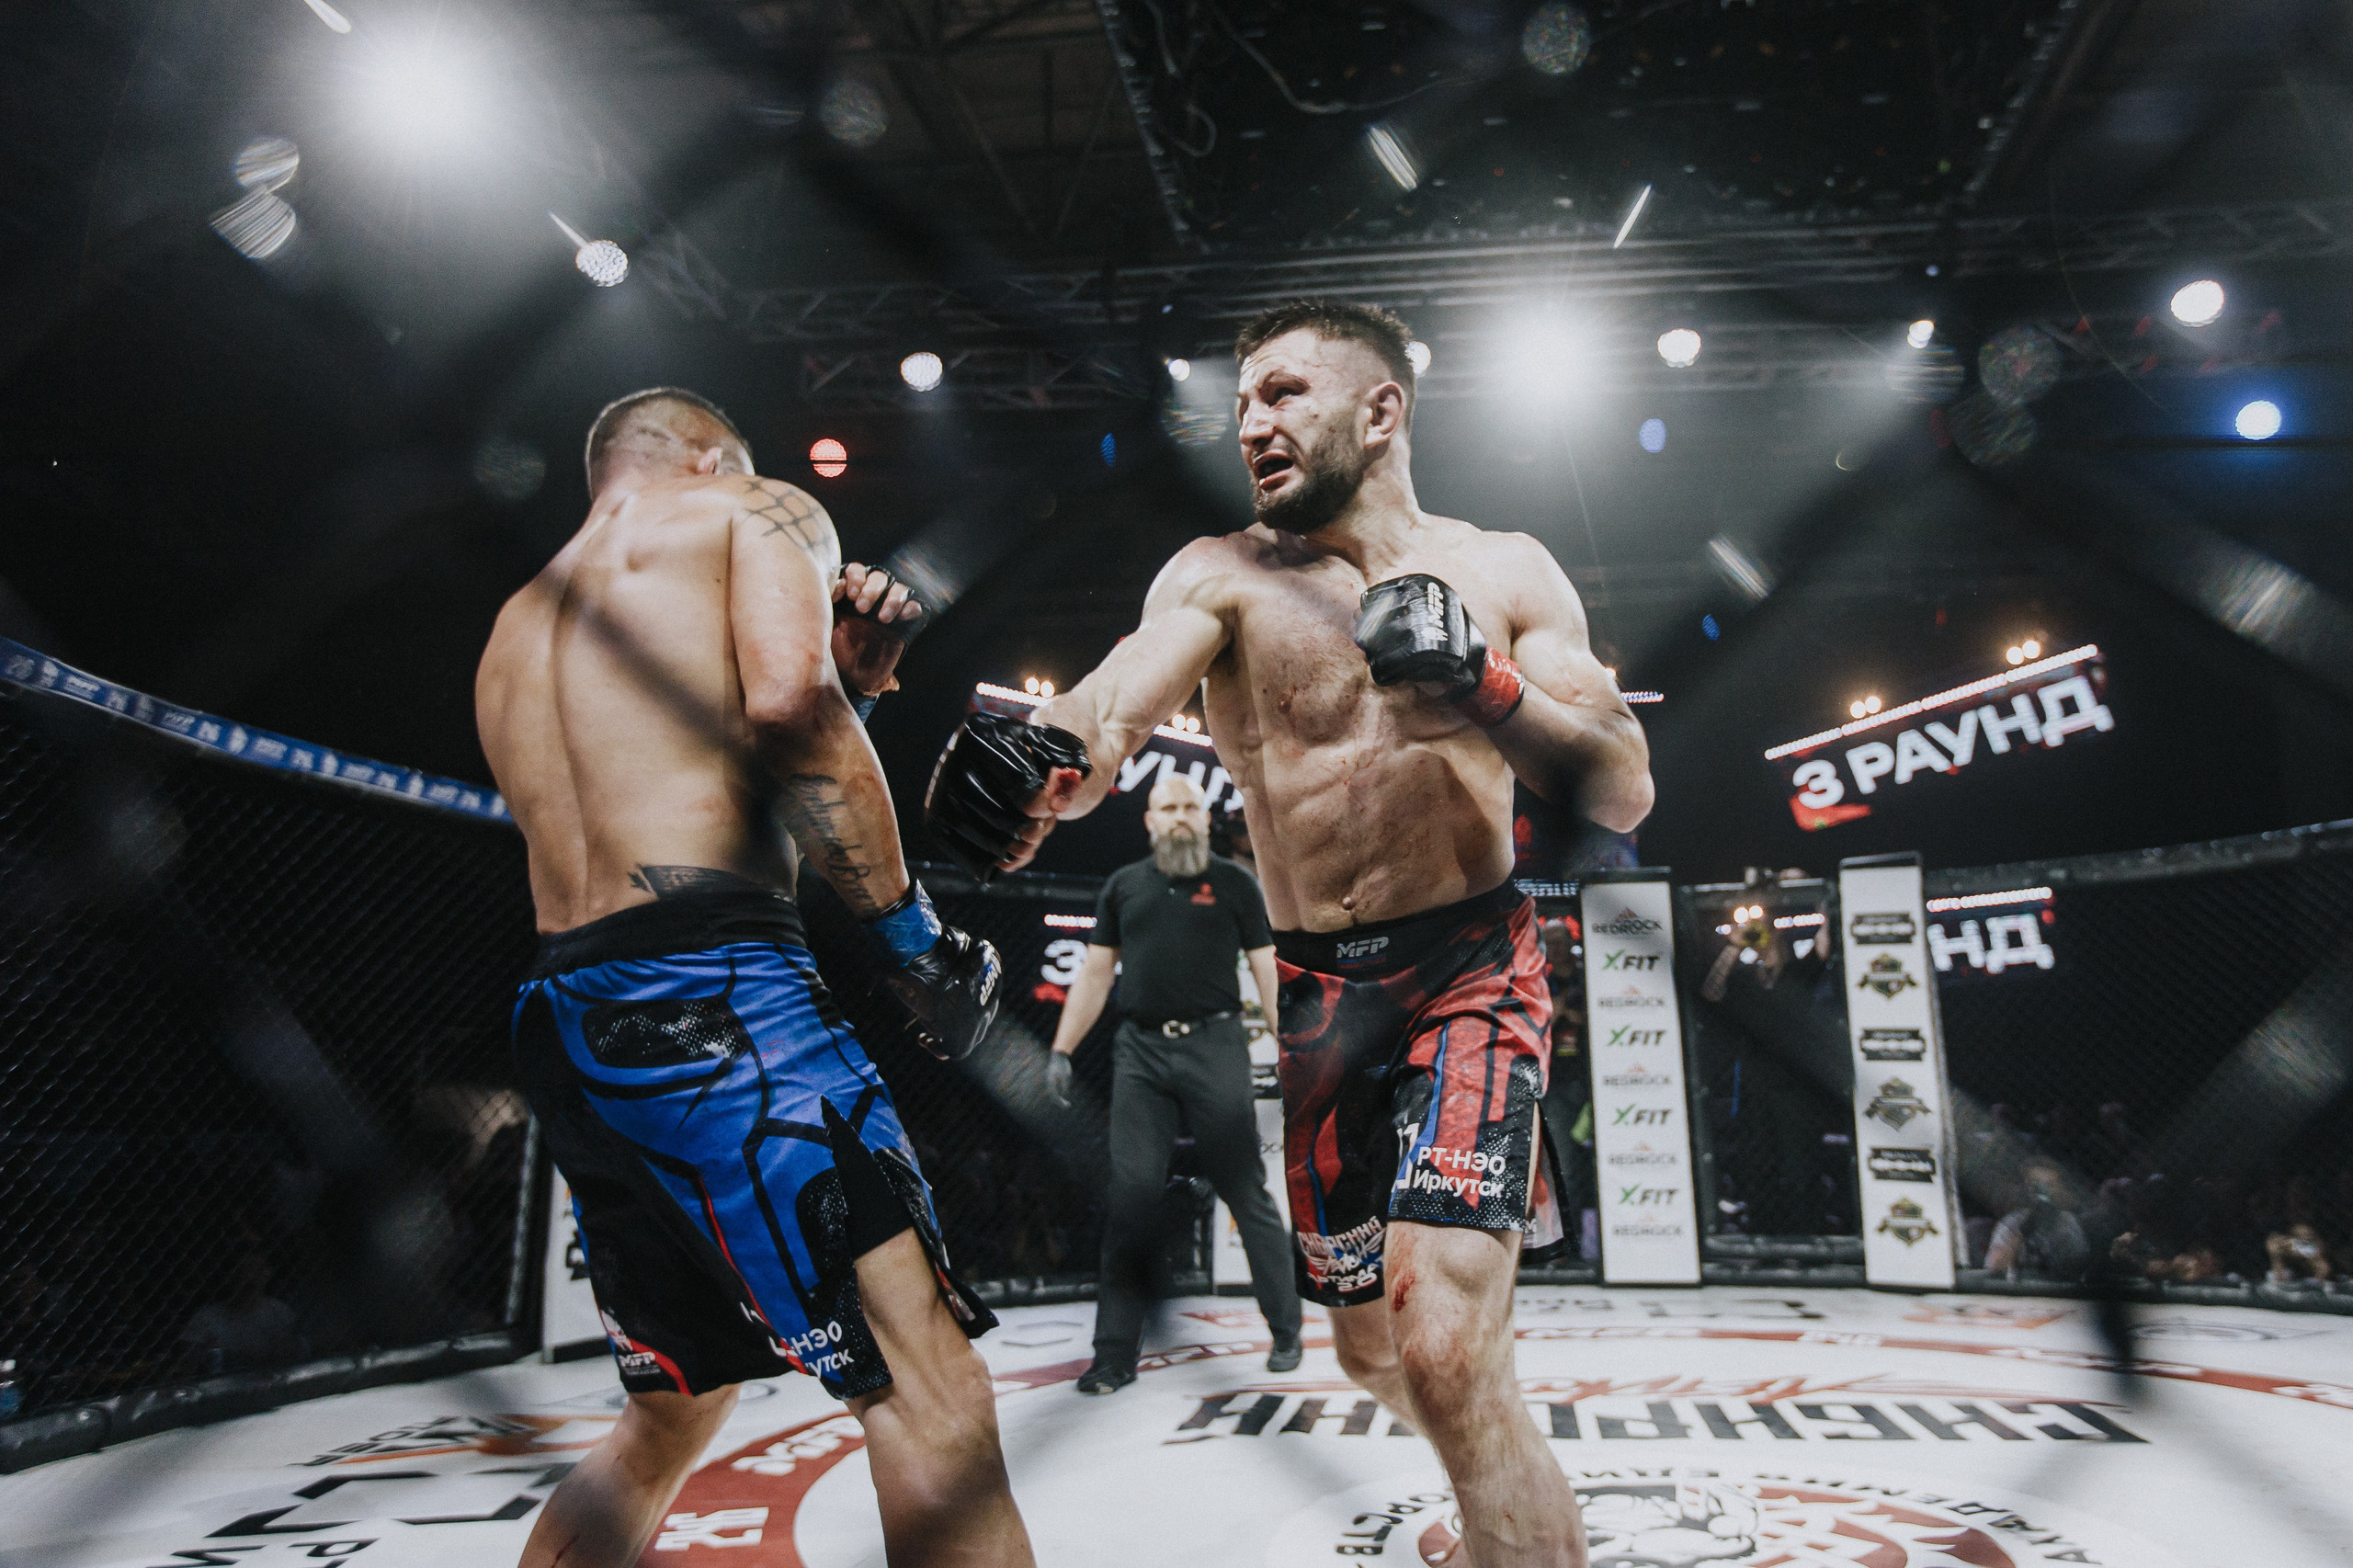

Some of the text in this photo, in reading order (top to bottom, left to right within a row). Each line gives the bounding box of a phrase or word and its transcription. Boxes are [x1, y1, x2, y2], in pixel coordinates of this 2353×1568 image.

[1792, 675, 2114, 809] 3 РАУНД
[1115, 750, 1245, 813] УНД
[1336, 936, 1390, 959] MFP
[1416, 1146, 1506, 1176] РТ-НЭО
[1412, 1169, 1506, 1199] Иркутск
[791, 1320, 843, 1356] НЭО
